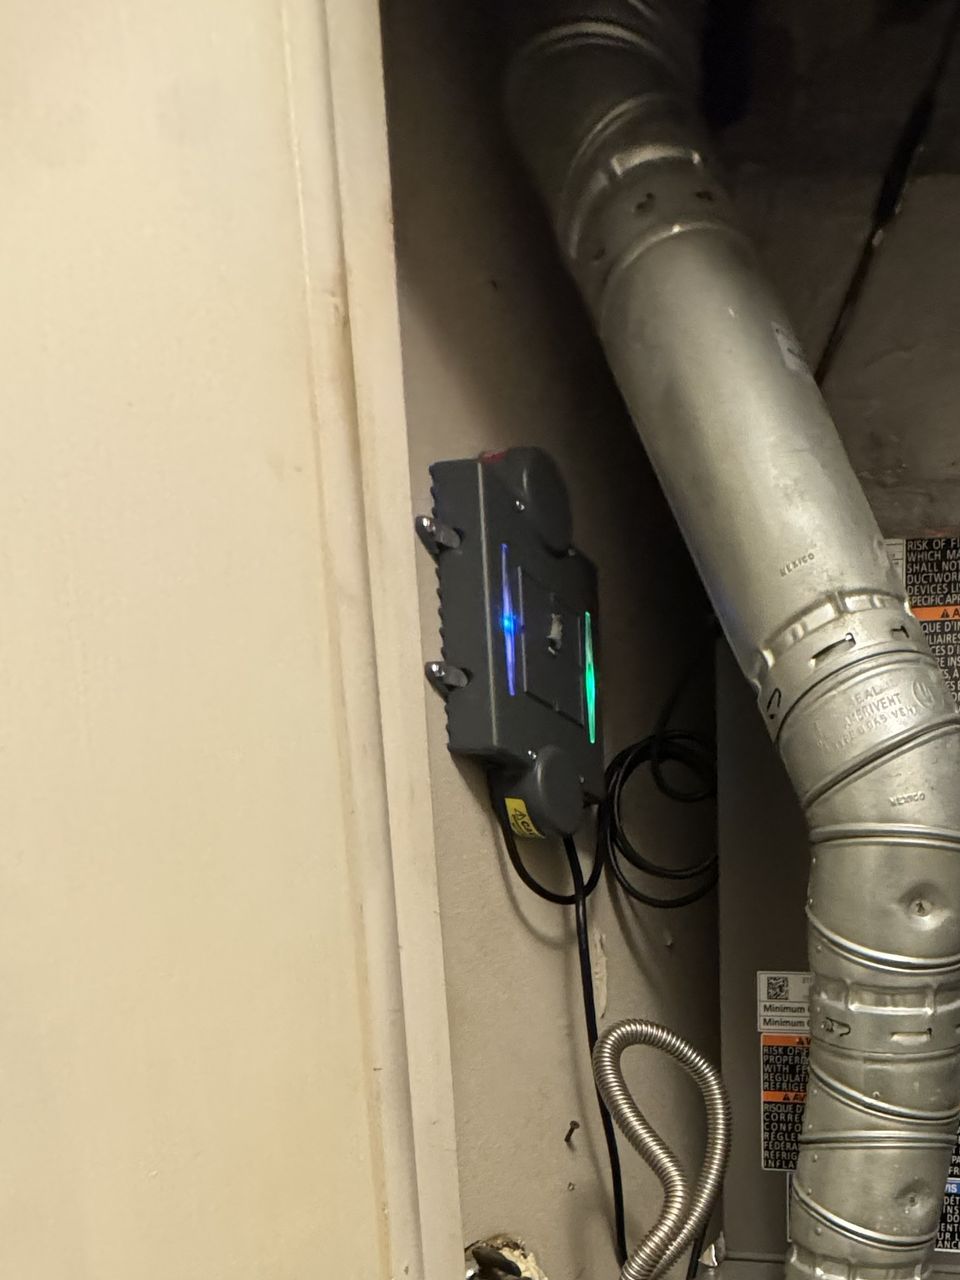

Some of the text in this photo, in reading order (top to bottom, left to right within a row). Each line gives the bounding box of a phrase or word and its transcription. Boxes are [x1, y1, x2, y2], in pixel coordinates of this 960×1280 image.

[907, 539, 929, 551] RISK
[932, 539, 948, 550] OF
[907, 551, 941, 562] WHICH
[780, 553, 815, 577] MEXICO
[906, 562, 939, 574] SHALL
[906, 583, 949, 595] DEVICES
[763, 1003, 806, 1013] Minimum
[763, 1017, 805, 1027] Minimum
[763, 1046, 784, 1055] RISK
[763, 1064, 790, 1073] WITH
[763, 1103, 794, 1113] RISQUE
